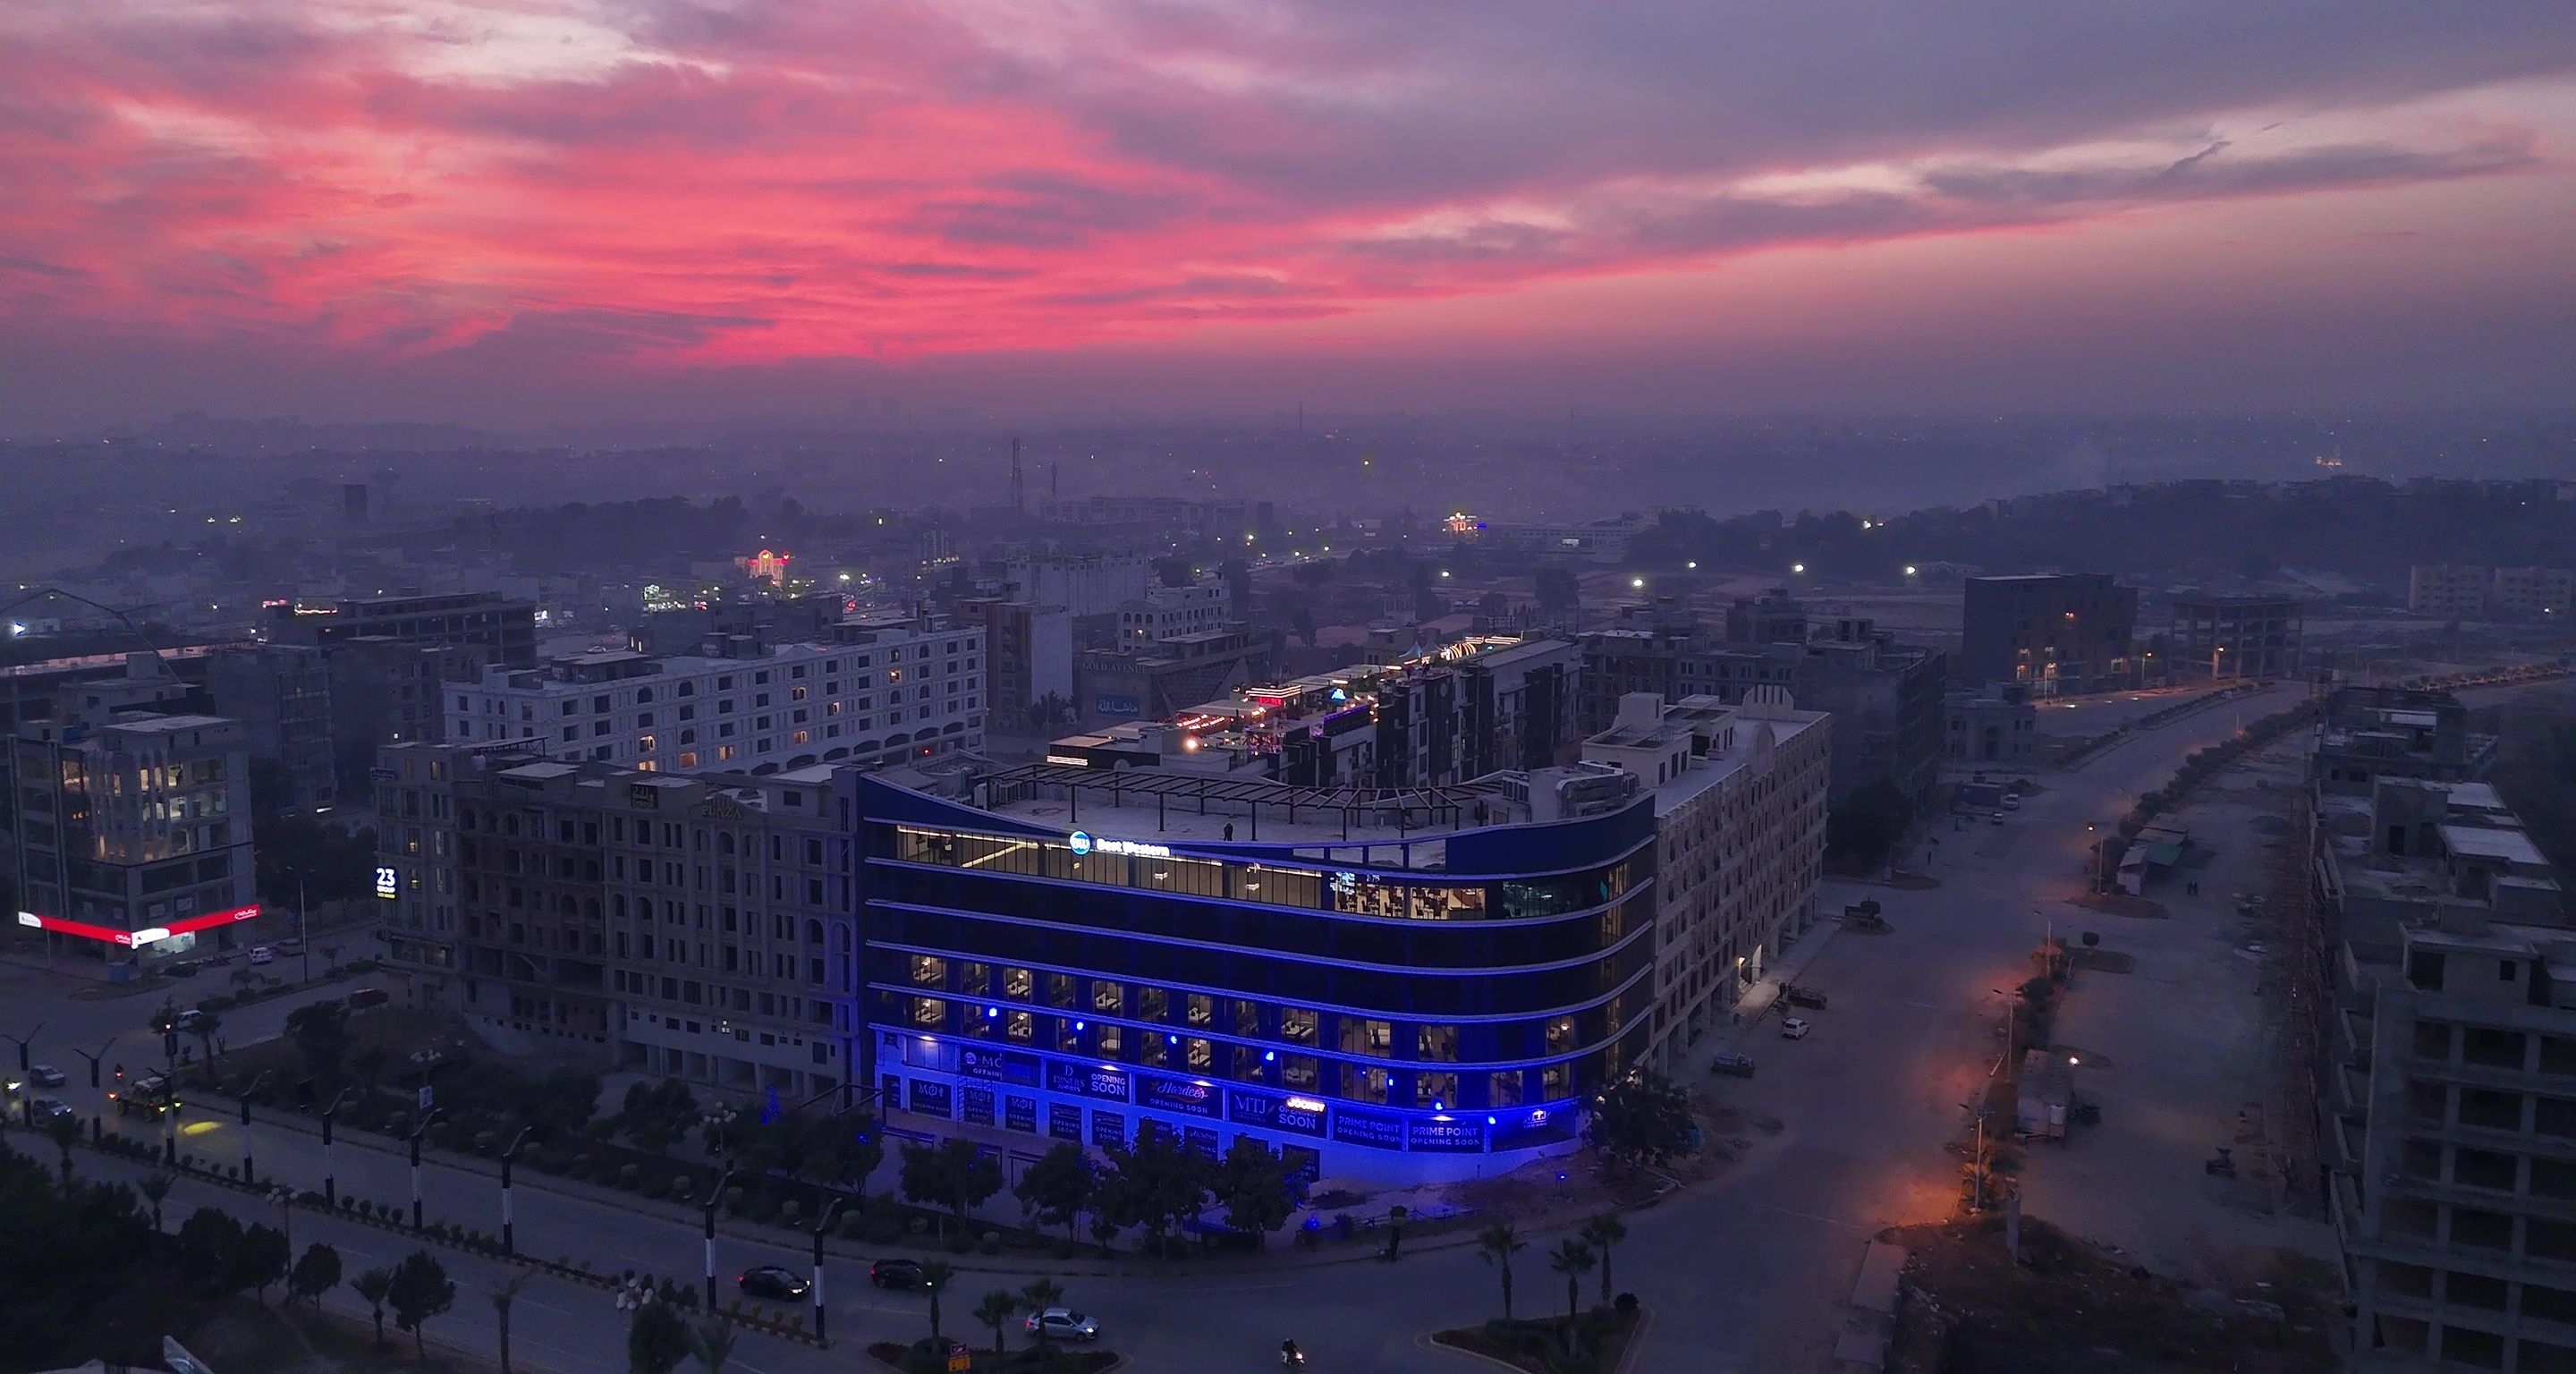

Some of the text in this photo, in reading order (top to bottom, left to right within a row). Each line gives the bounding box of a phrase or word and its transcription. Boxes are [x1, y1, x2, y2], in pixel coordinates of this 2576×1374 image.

[1081, 662, 1152, 674] GOLD AVENUE
[1097, 838, 1123, 852] Best
[377, 868, 395, 886] 23
[972, 1067, 1002, 1078] OPENIN
[1090, 1073, 1126, 1085] OPENING
[1091, 1081, 1125, 1096] SOON
[1149, 1098, 1208, 1114] OPENING SOON
[1234, 1094, 1266, 1114] MTJ
[1278, 1113, 1316, 1130] SOON
[1338, 1115, 1401, 1133] PRIME POINT
[1336, 1127, 1402, 1144] OPENING SOON
[1412, 1126, 1479, 1137] PRIME POINT
[1411, 1137, 1480, 1146] OPENING SOON
